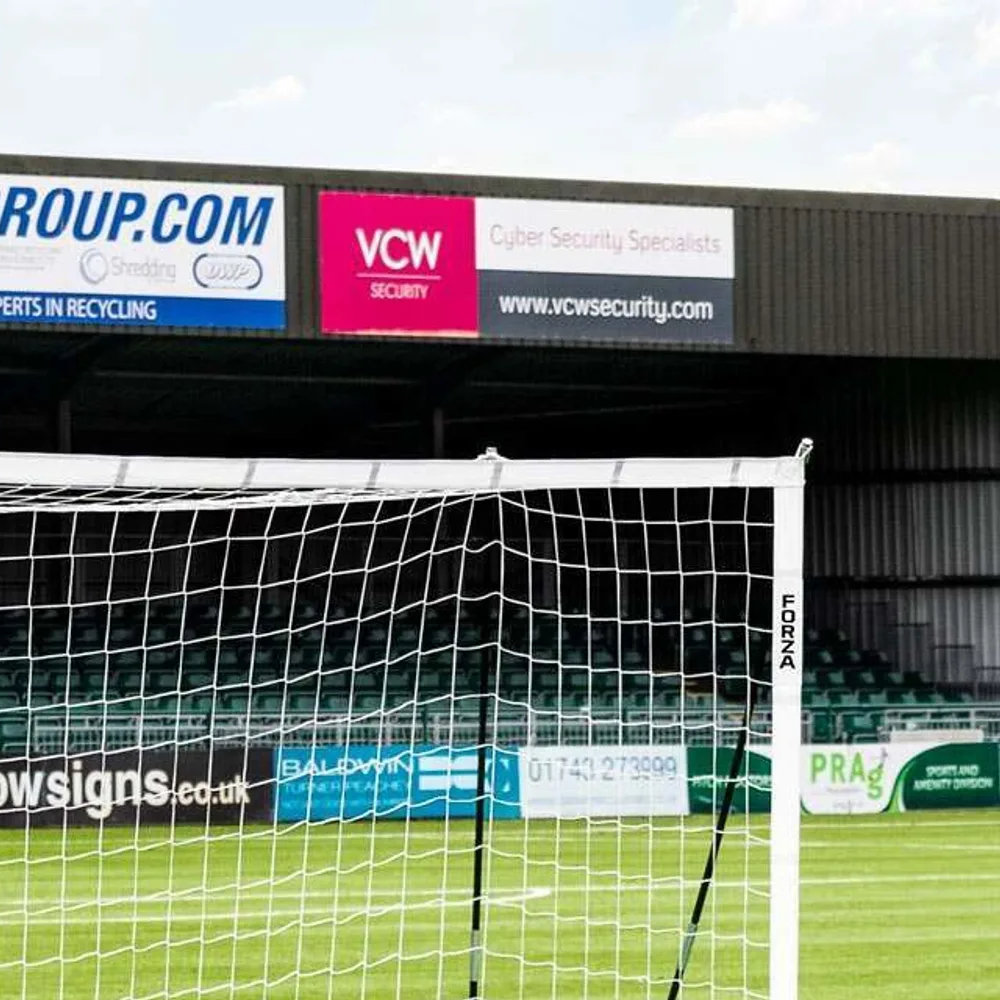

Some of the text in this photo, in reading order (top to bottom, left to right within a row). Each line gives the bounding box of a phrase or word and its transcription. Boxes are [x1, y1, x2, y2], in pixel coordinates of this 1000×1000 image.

[355, 228, 442, 270] VCW
[490, 225, 722, 254] Cyber Security Specialists
[111, 256, 176, 278] Shredding
[370, 282, 429, 300] SECURITY
[45, 297, 64, 317] IN
[68, 299, 157, 320] RECYCLING
[499, 295, 713, 324] www.vcwsecurity.com
[780, 595, 795, 669] FORZA
